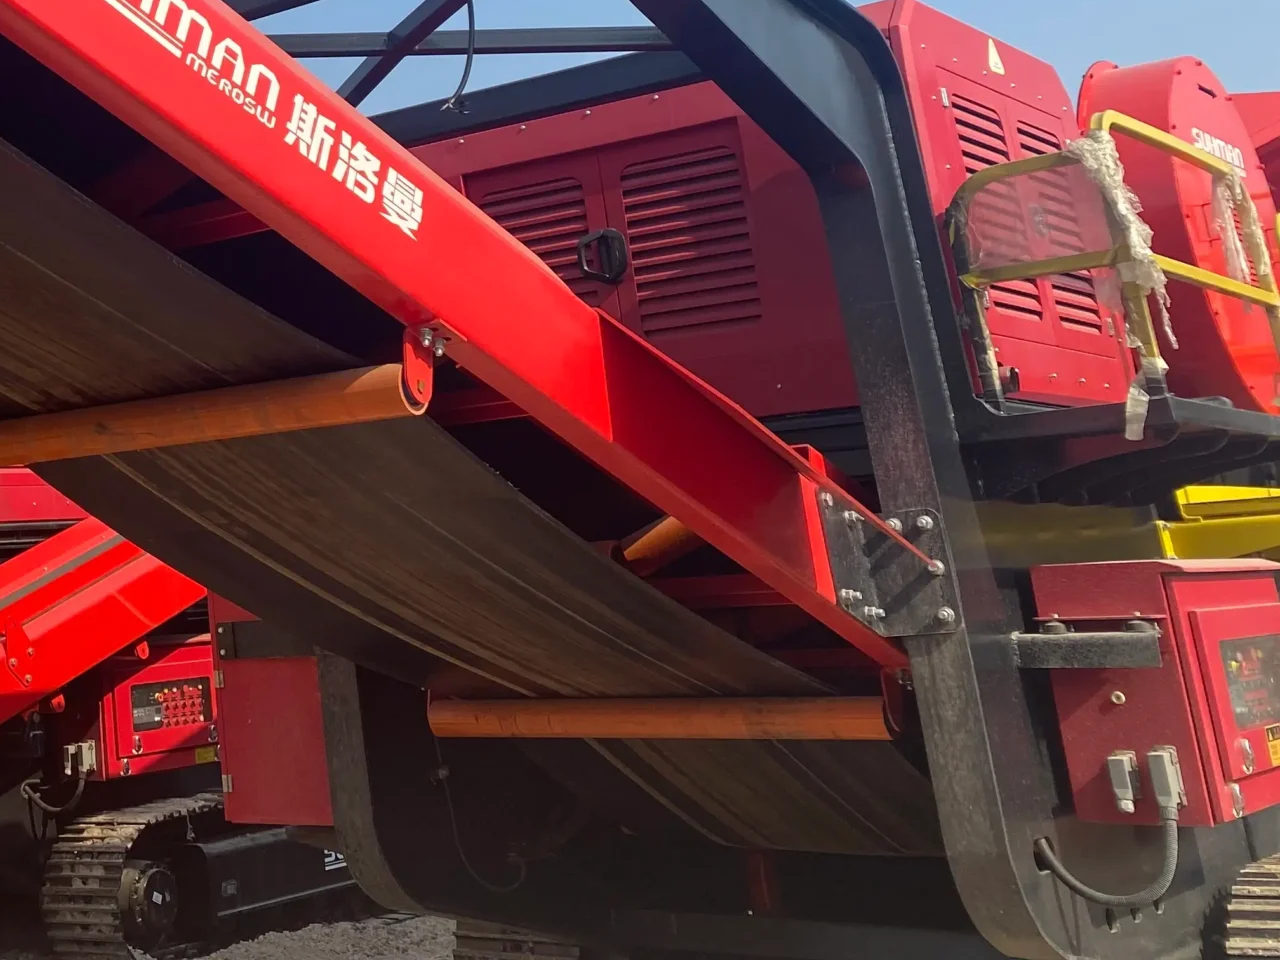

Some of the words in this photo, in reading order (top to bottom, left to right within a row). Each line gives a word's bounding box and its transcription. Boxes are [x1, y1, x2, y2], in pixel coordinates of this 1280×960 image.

[186, 52, 276, 129] MEROSW
[284, 93, 424, 241] 斯洛曼
